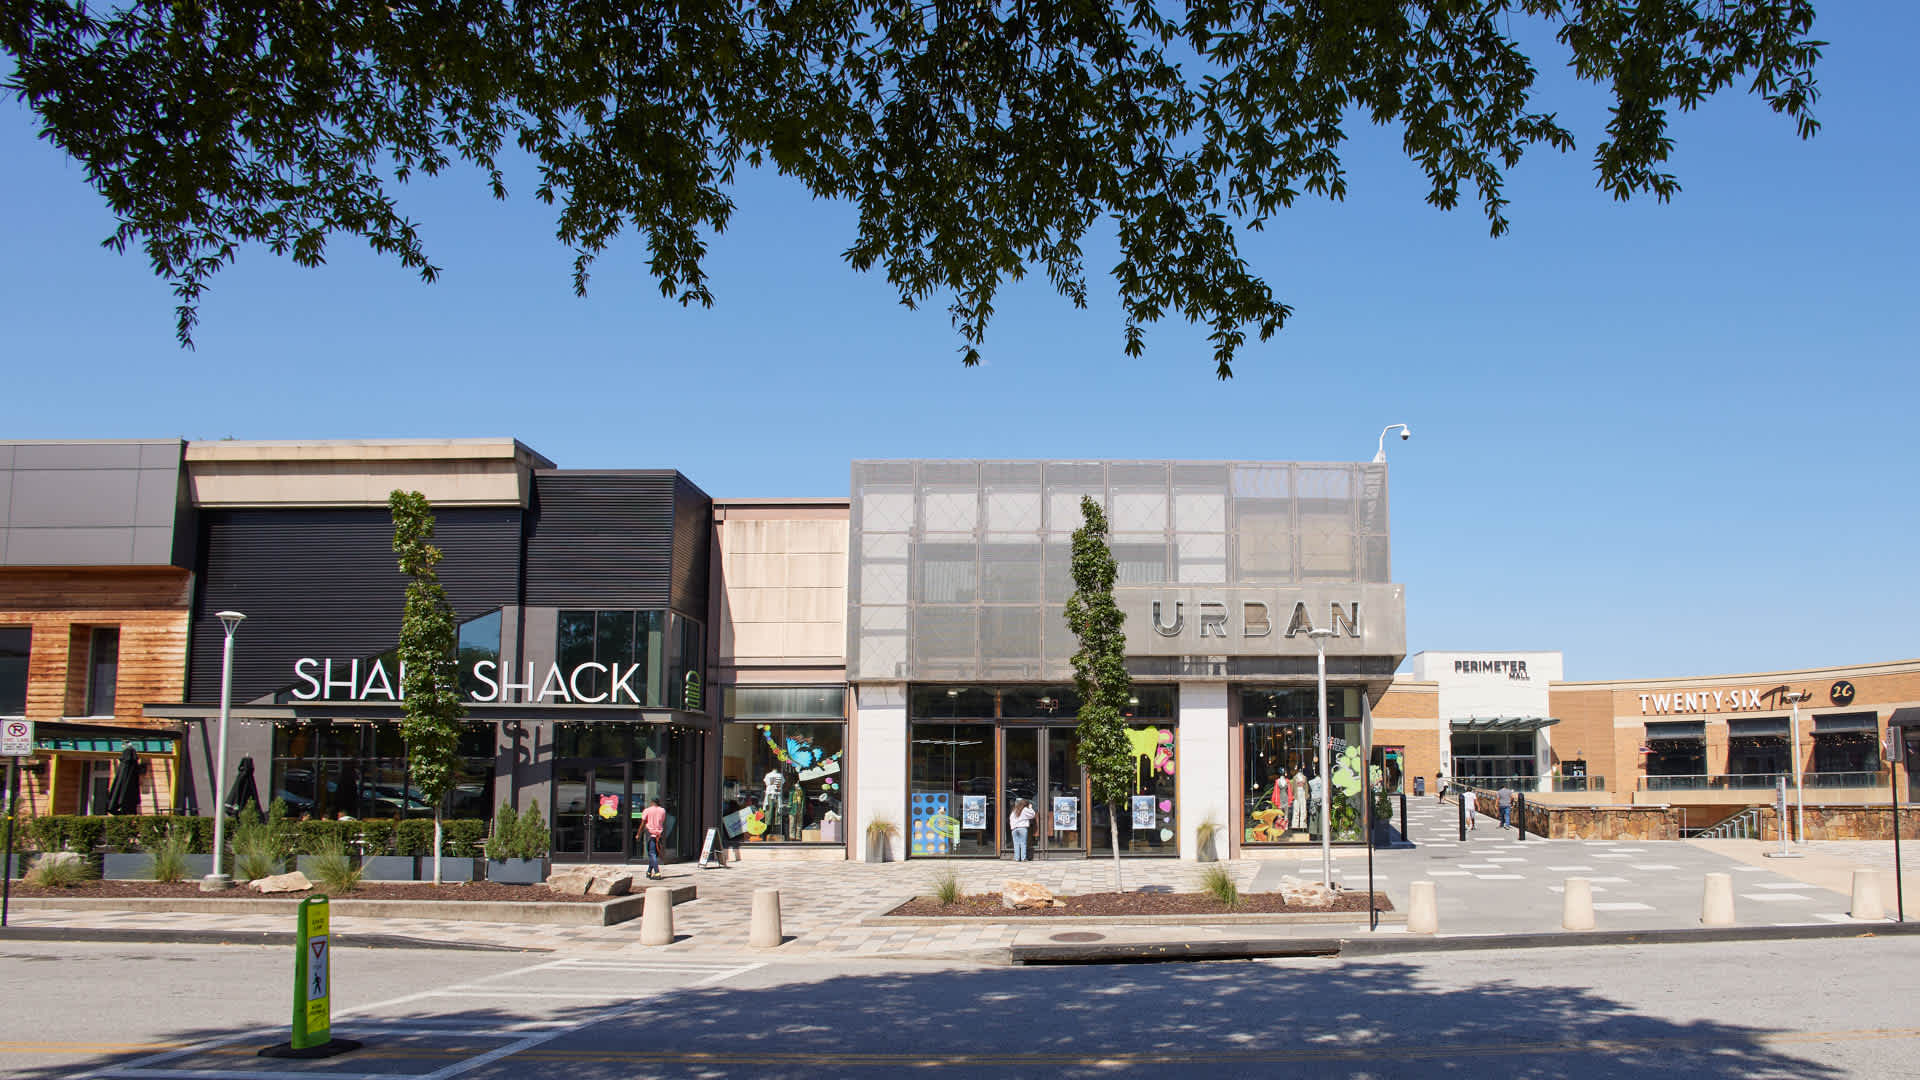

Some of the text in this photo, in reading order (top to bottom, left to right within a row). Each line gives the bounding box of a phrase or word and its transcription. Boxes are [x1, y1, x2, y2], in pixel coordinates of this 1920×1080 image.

[1152, 600, 1361, 638] URBAN
[1454, 660, 1528, 673] PERIMETER
[1508, 672, 1531, 681] MALL
[470, 660, 641, 704] SHACK
